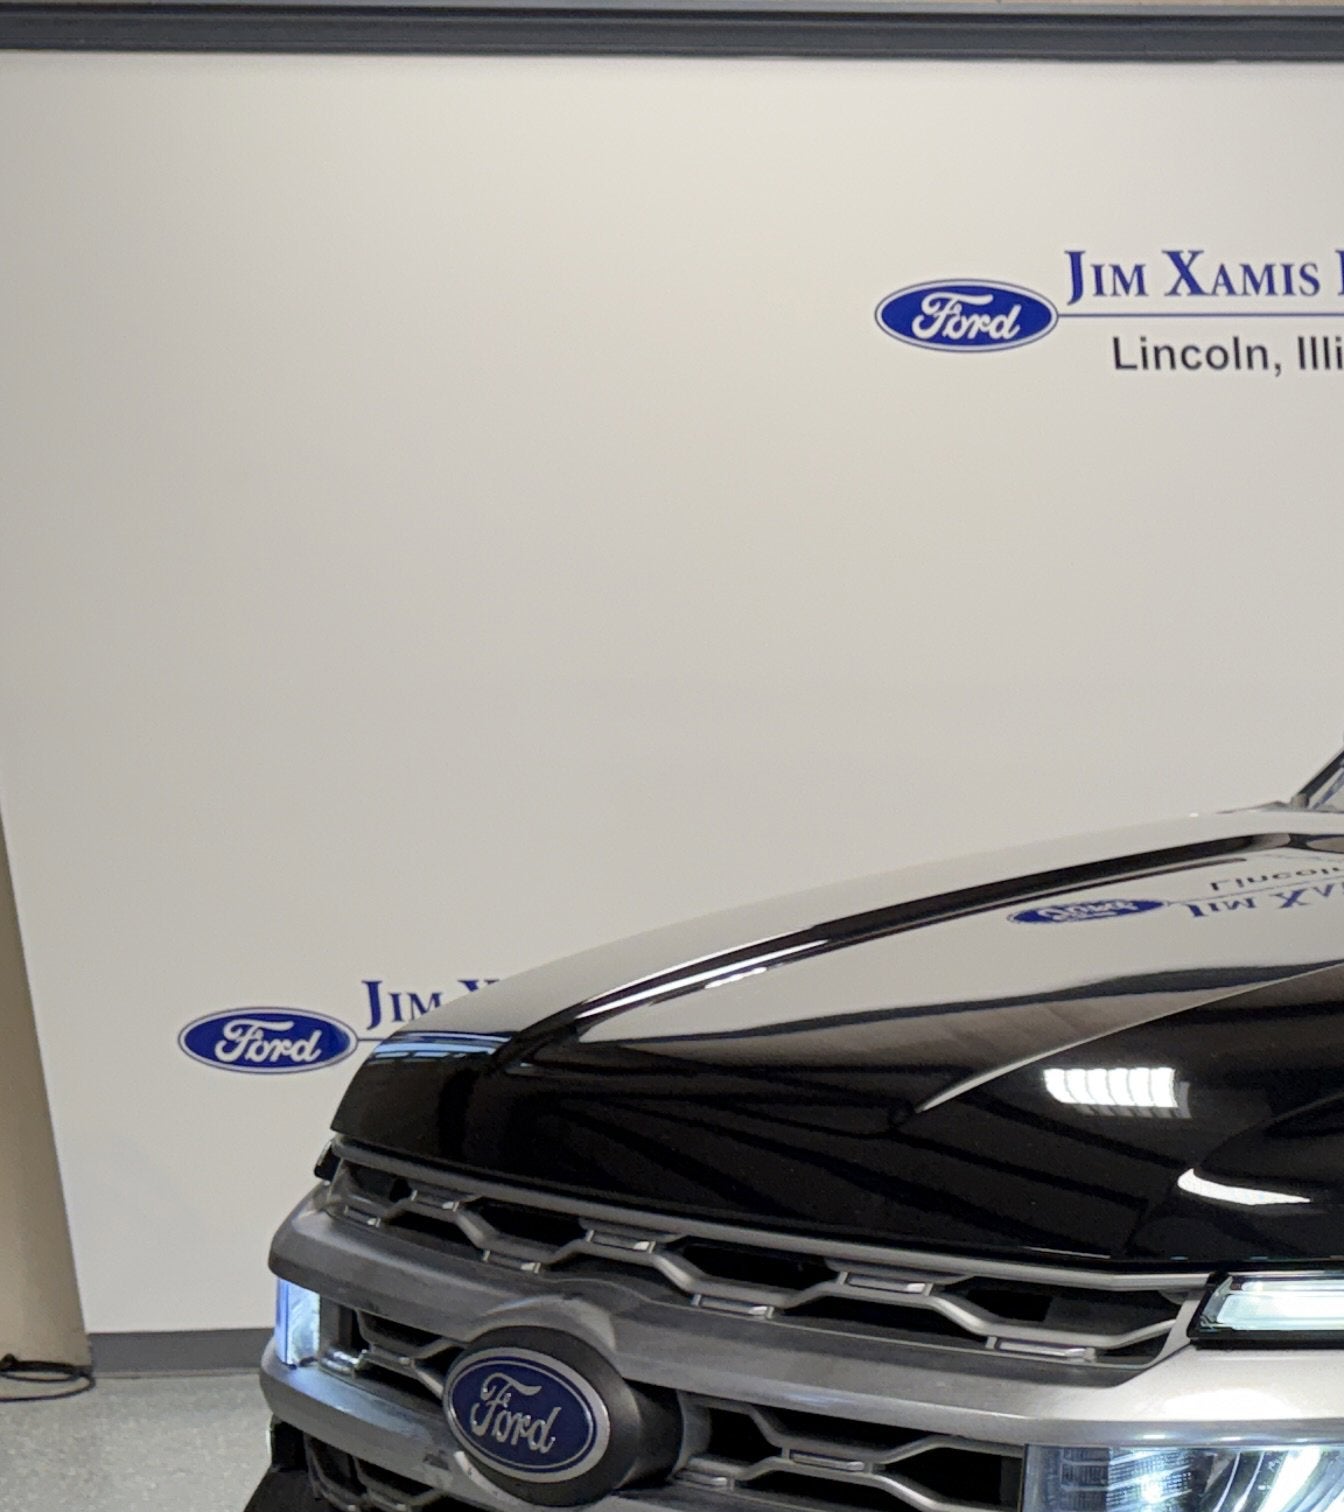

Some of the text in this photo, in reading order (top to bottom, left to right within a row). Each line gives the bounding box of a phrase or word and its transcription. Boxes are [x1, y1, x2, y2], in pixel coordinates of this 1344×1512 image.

[1064, 249, 1147, 306] JIM
[1161, 249, 1321, 298] XAMIS
[912, 291, 1021, 340] Ford
[1112, 335, 1282, 376] Lincoln,
[214, 1019, 322, 1063] Ford
[470, 1371, 563, 1455] Ford
